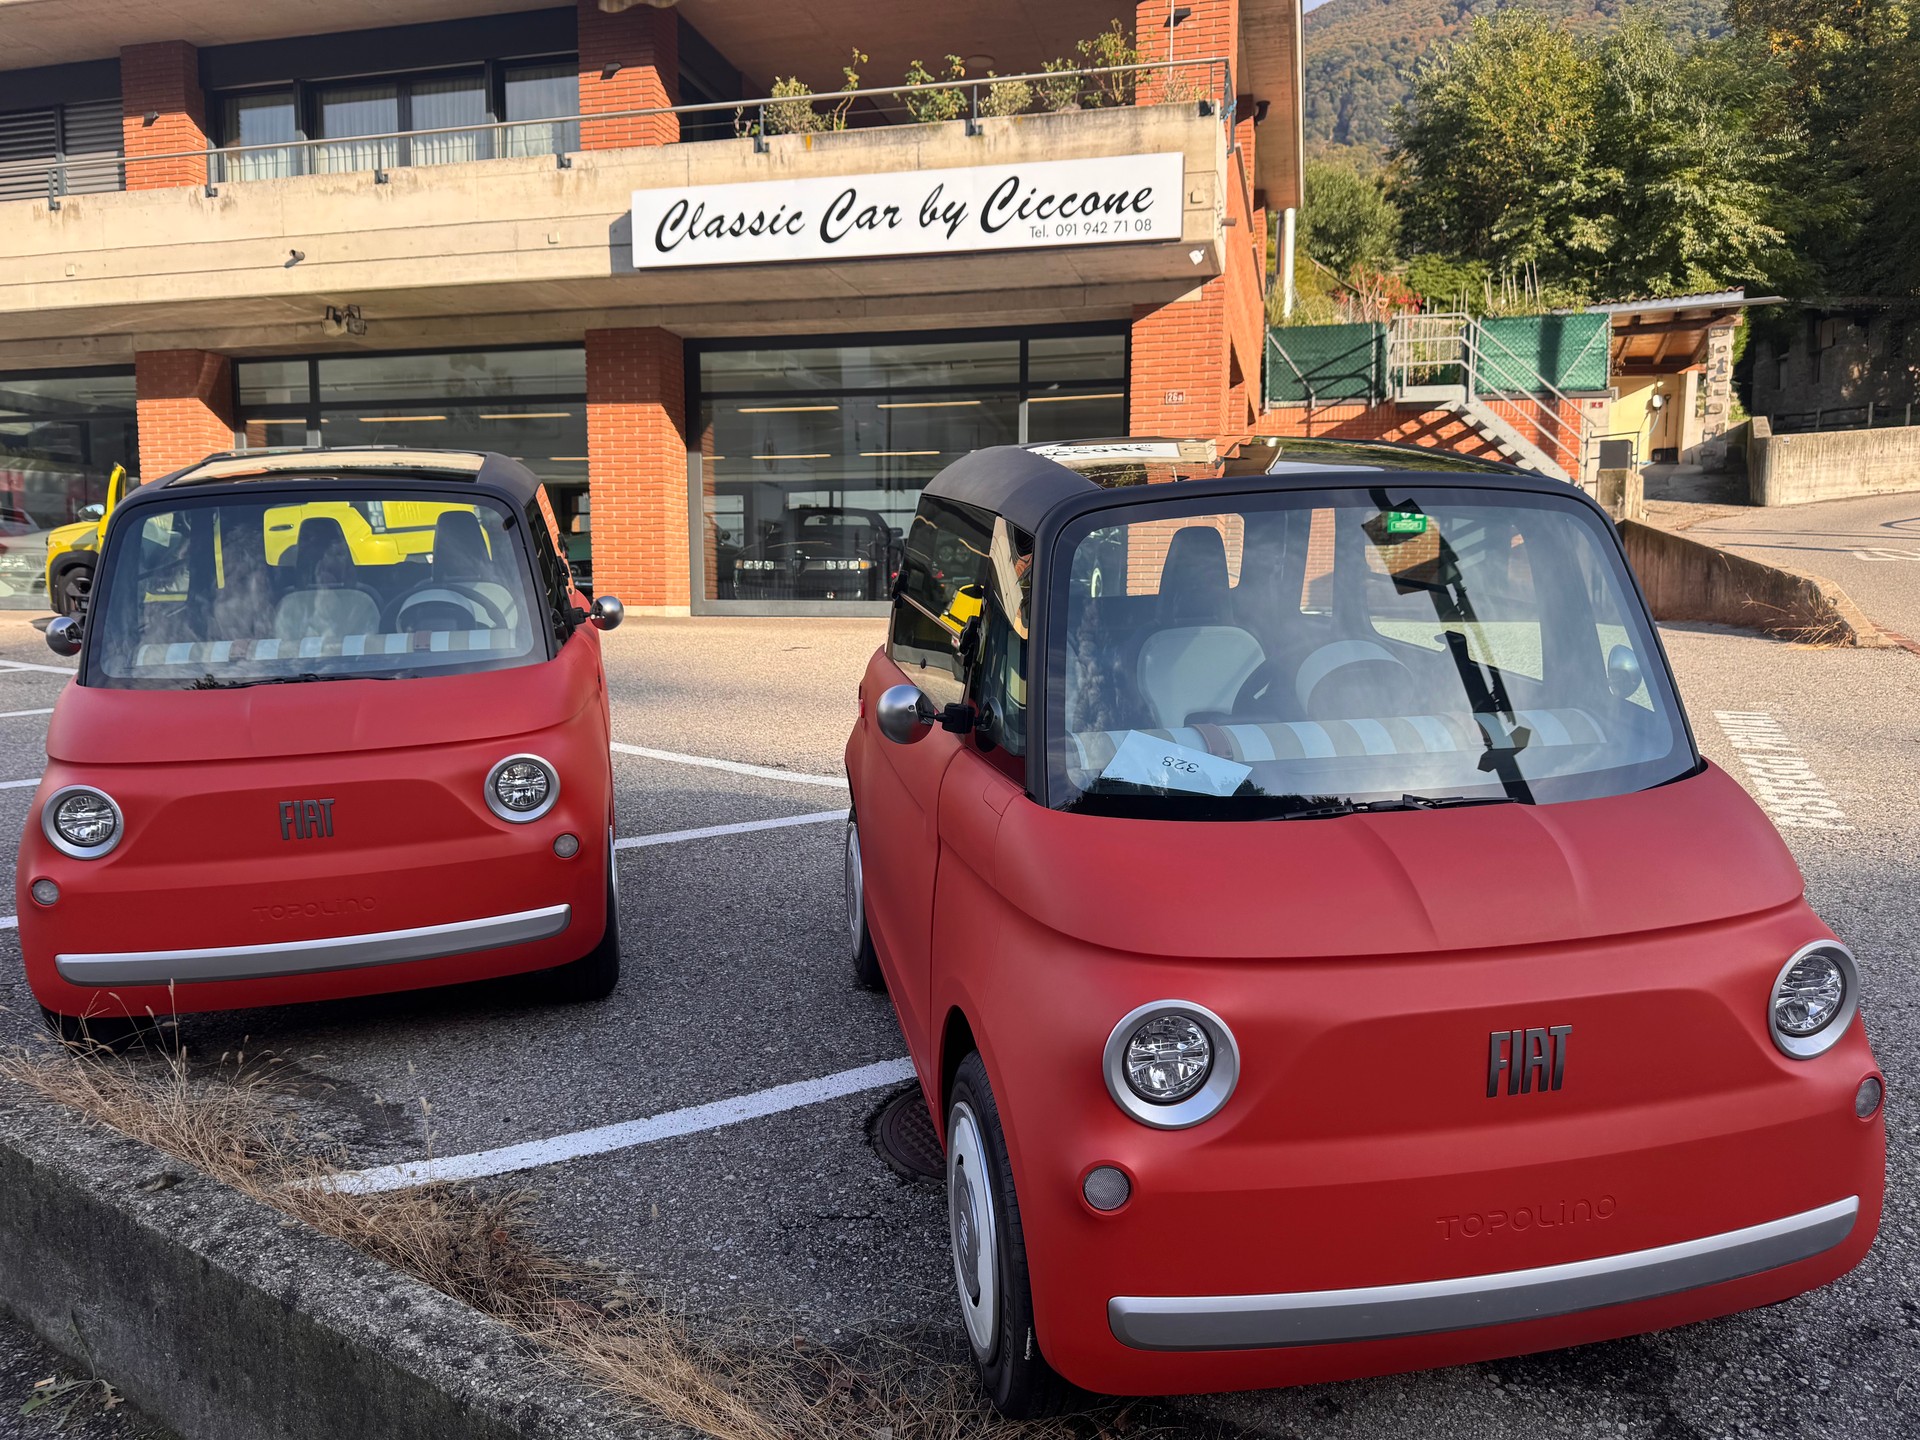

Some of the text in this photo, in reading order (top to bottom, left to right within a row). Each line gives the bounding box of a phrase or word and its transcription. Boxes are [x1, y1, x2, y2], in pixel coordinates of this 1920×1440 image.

[655, 175, 1154, 252] Classic Car by Ciccone
[1029, 219, 1152, 238] Tel. 091 942 71 08
[1162, 756, 1199, 773] 328
[279, 798, 335, 840] FIAT
[1486, 1024, 1572, 1098] FIAT
